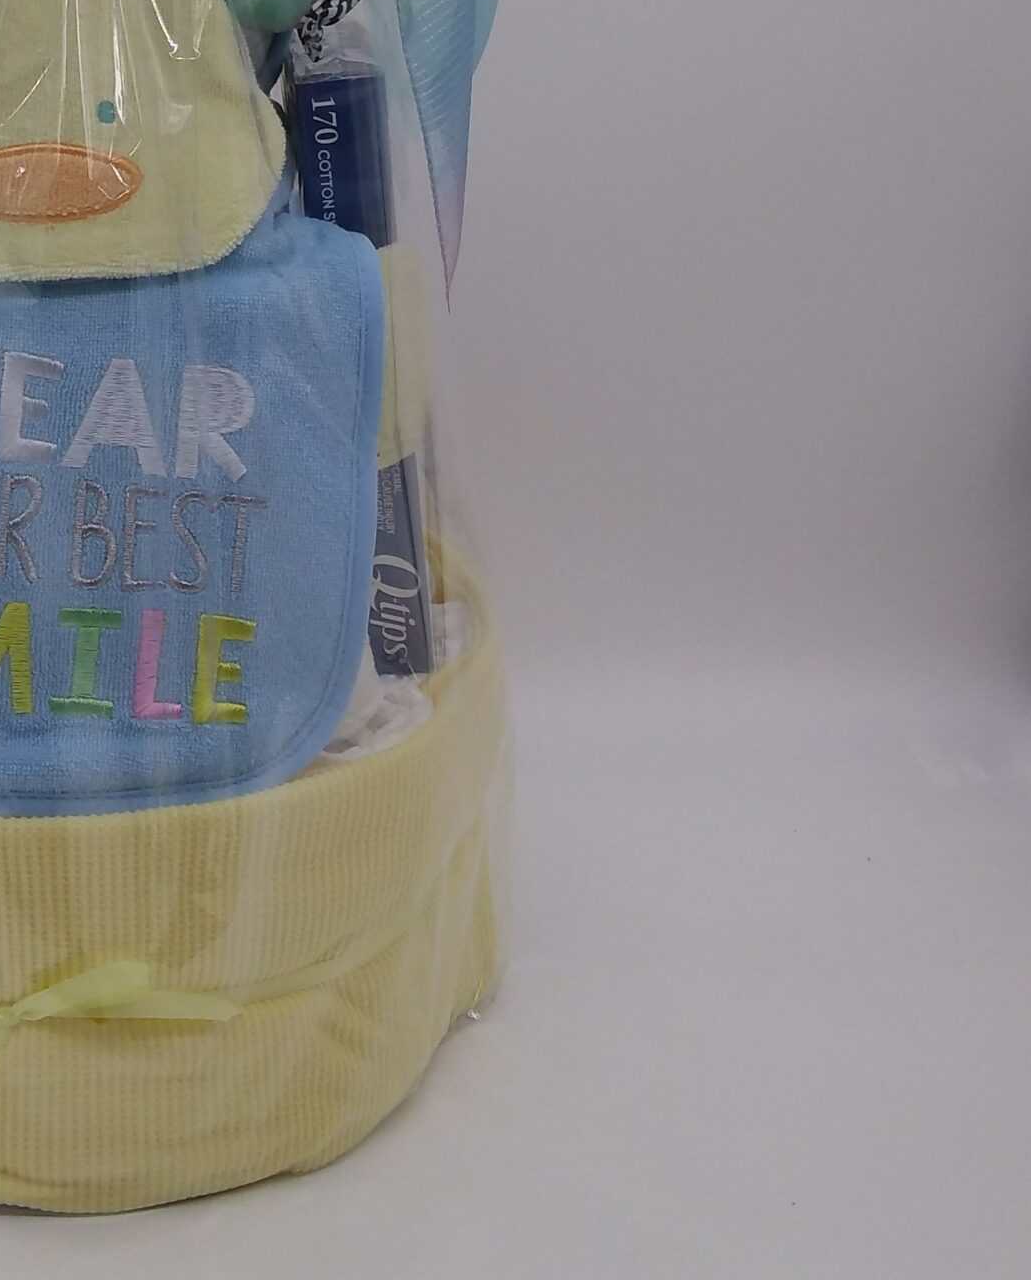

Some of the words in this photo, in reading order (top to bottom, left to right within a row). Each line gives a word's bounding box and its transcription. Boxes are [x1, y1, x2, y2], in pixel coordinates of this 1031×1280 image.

[311, 96, 339, 144] 170
[317, 149, 335, 209] COTTON
[70, 478, 267, 600] BEST
